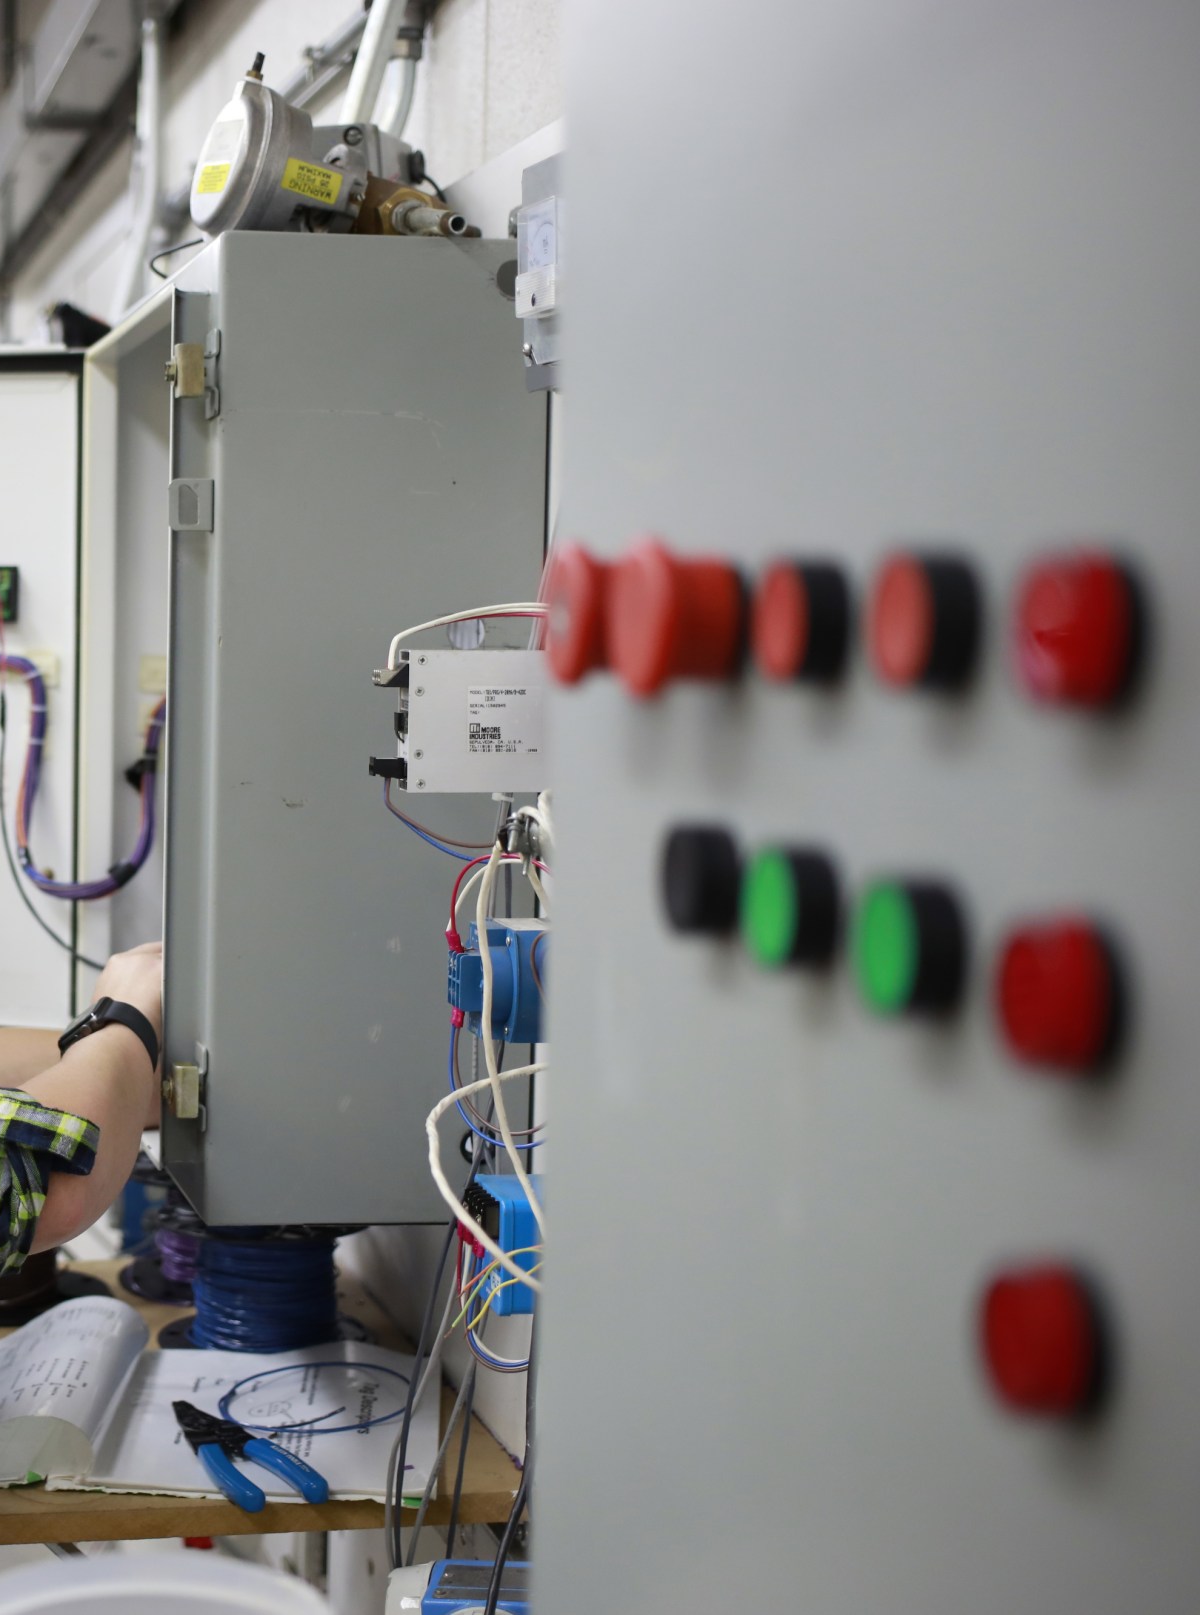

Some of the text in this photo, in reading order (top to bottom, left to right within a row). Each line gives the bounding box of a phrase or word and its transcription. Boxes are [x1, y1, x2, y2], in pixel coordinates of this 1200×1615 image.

[298, 165, 332, 180] MAXIMUM
[288, 178, 332, 199] WARNING
[358, 1383, 380, 1395] Tag
